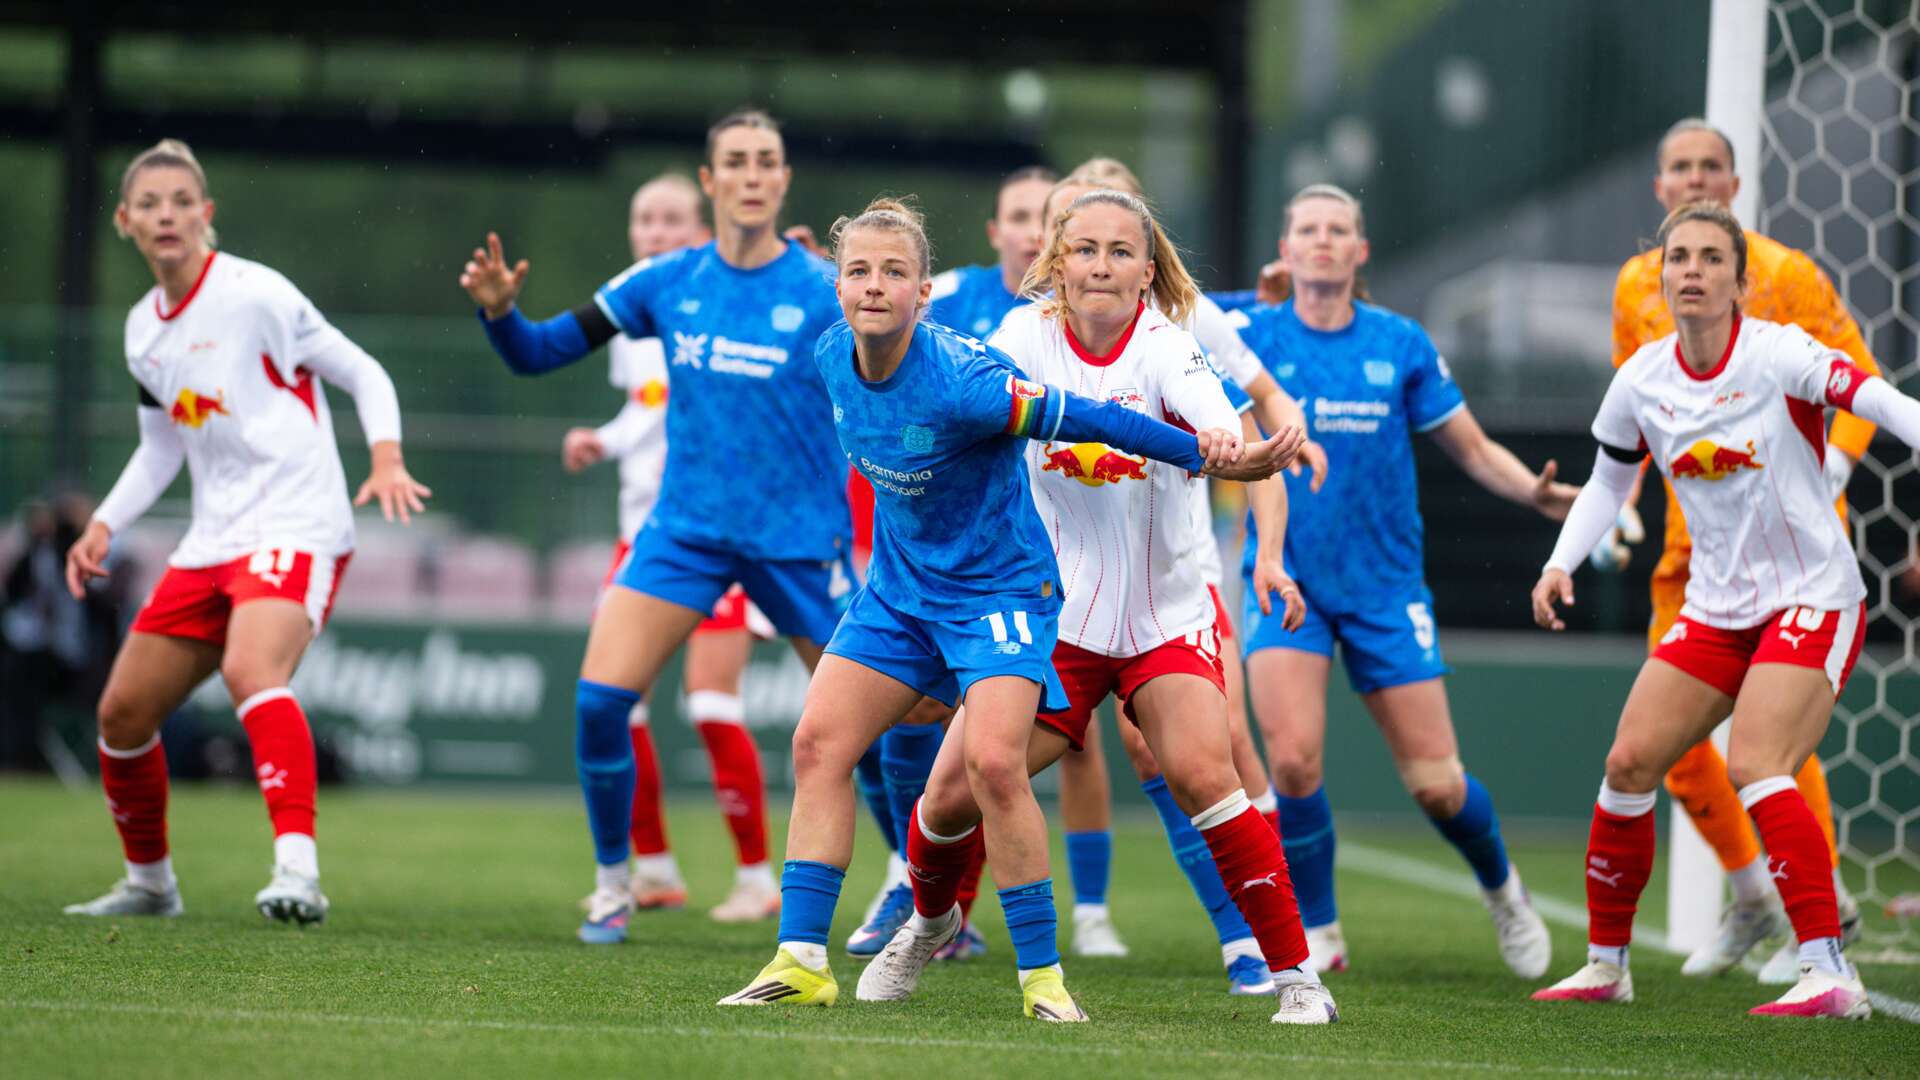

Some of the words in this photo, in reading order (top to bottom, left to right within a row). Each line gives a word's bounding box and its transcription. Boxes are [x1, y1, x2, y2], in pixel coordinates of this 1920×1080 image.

[712, 336, 788, 365] Barmenia
[708, 354, 775, 379] Gothaer
[1314, 397, 1390, 417] Barmenia
[1314, 416, 1380, 433] Gothaer
[860, 457, 933, 482] Barmenia
[979, 610, 1033, 645] 11
[1406, 602, 1435, 650] 5
